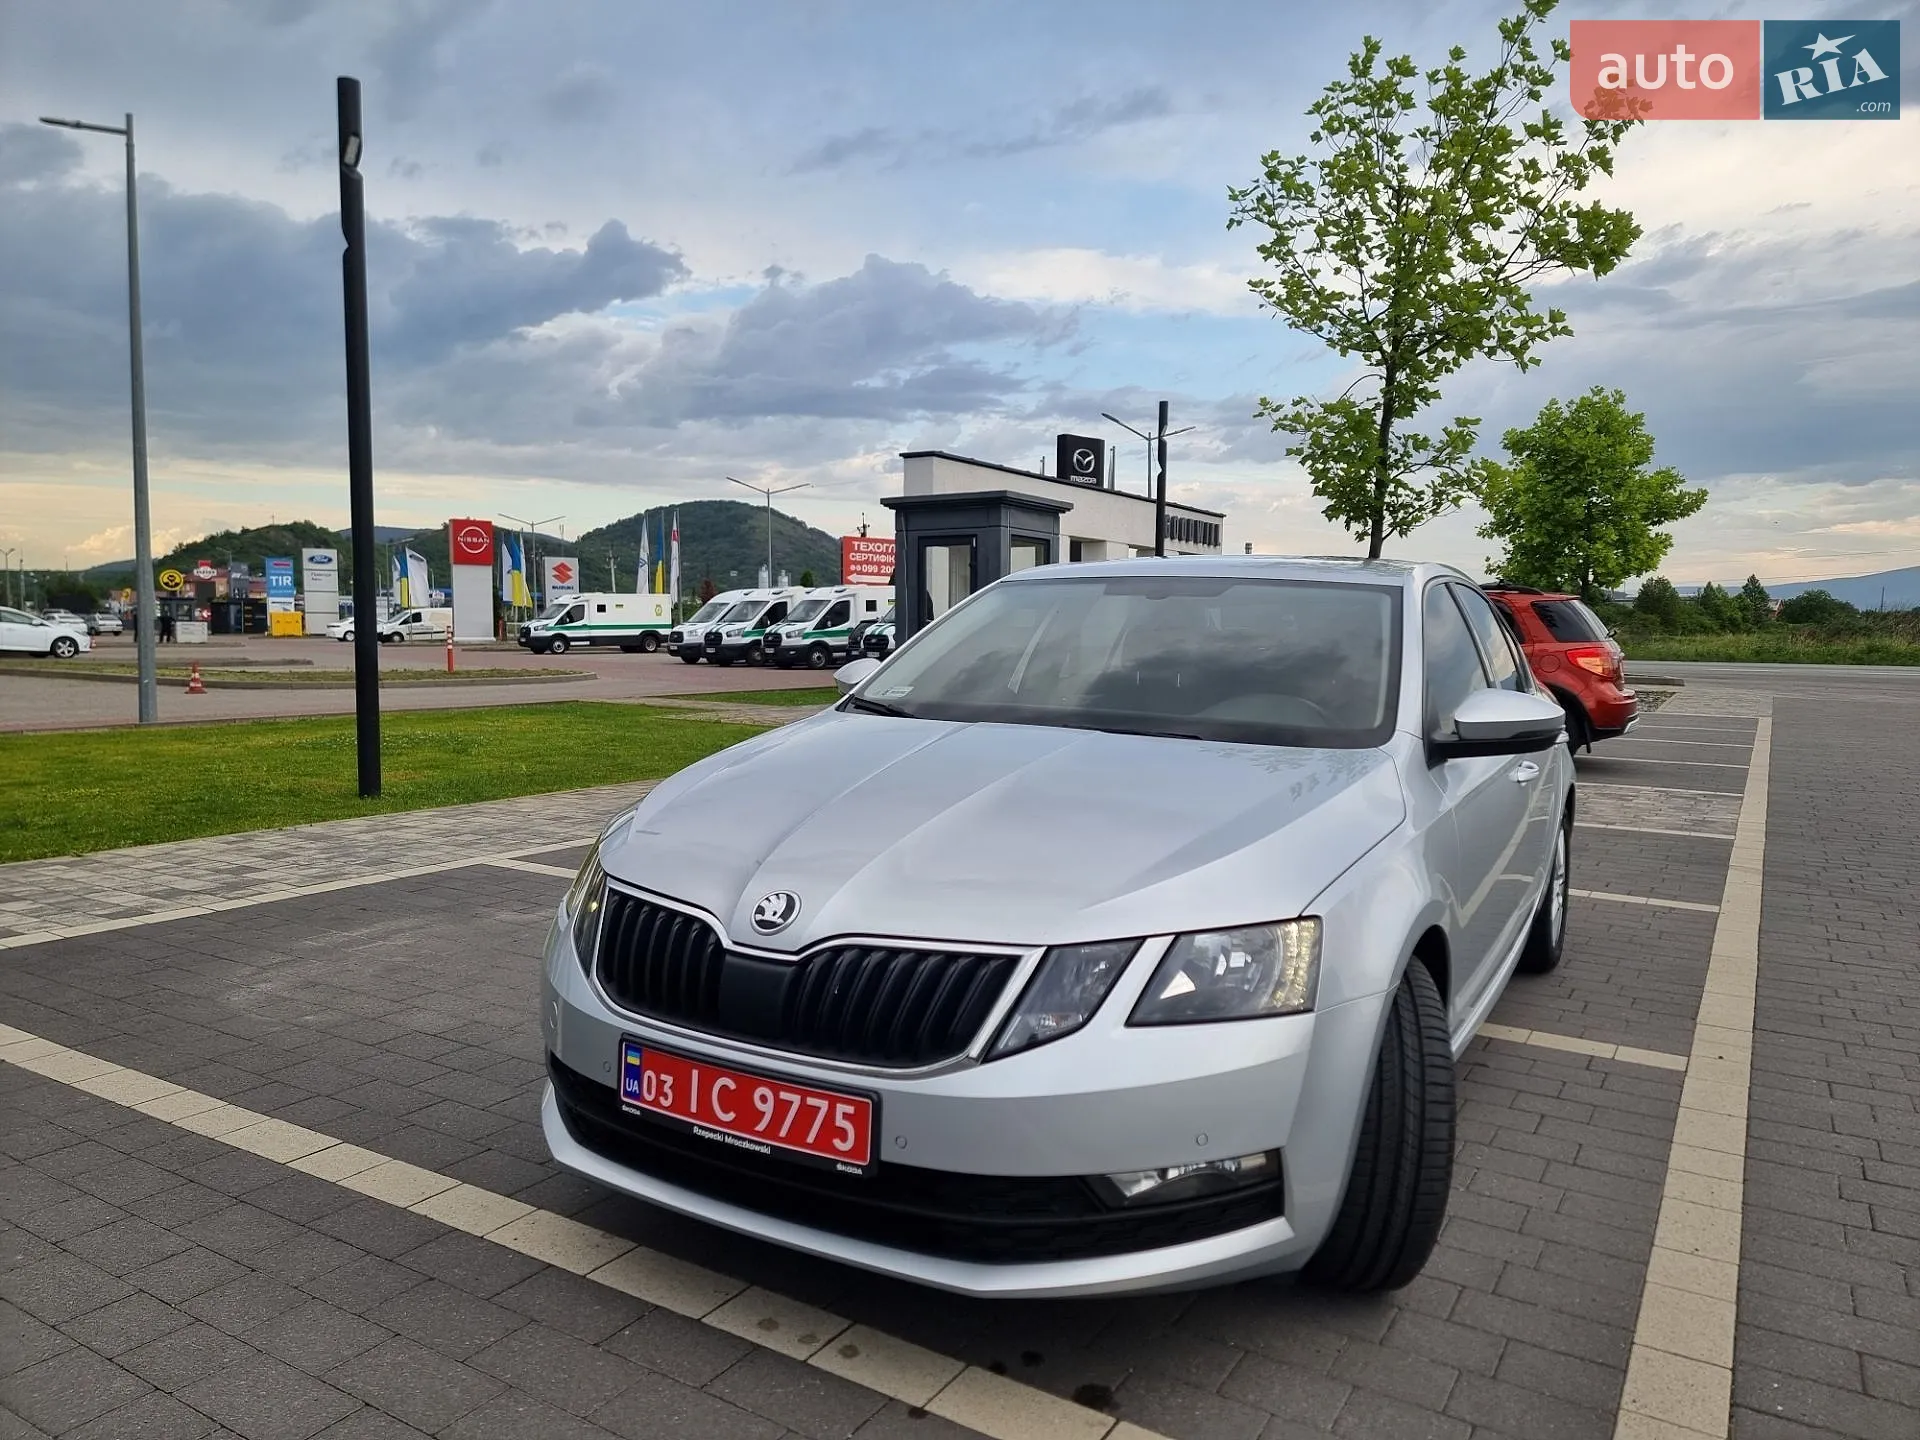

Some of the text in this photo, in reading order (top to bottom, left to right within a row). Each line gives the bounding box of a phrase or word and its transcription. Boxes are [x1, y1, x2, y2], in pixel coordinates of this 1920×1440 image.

[457, 536, 490, 544] NISSAN
[270, 575, 292, 587] TIR
[625, 1077, 640, 1095] UA
[642, 1069, 674, 1108] 03
[752, 1086, 856, 1152] 9775
